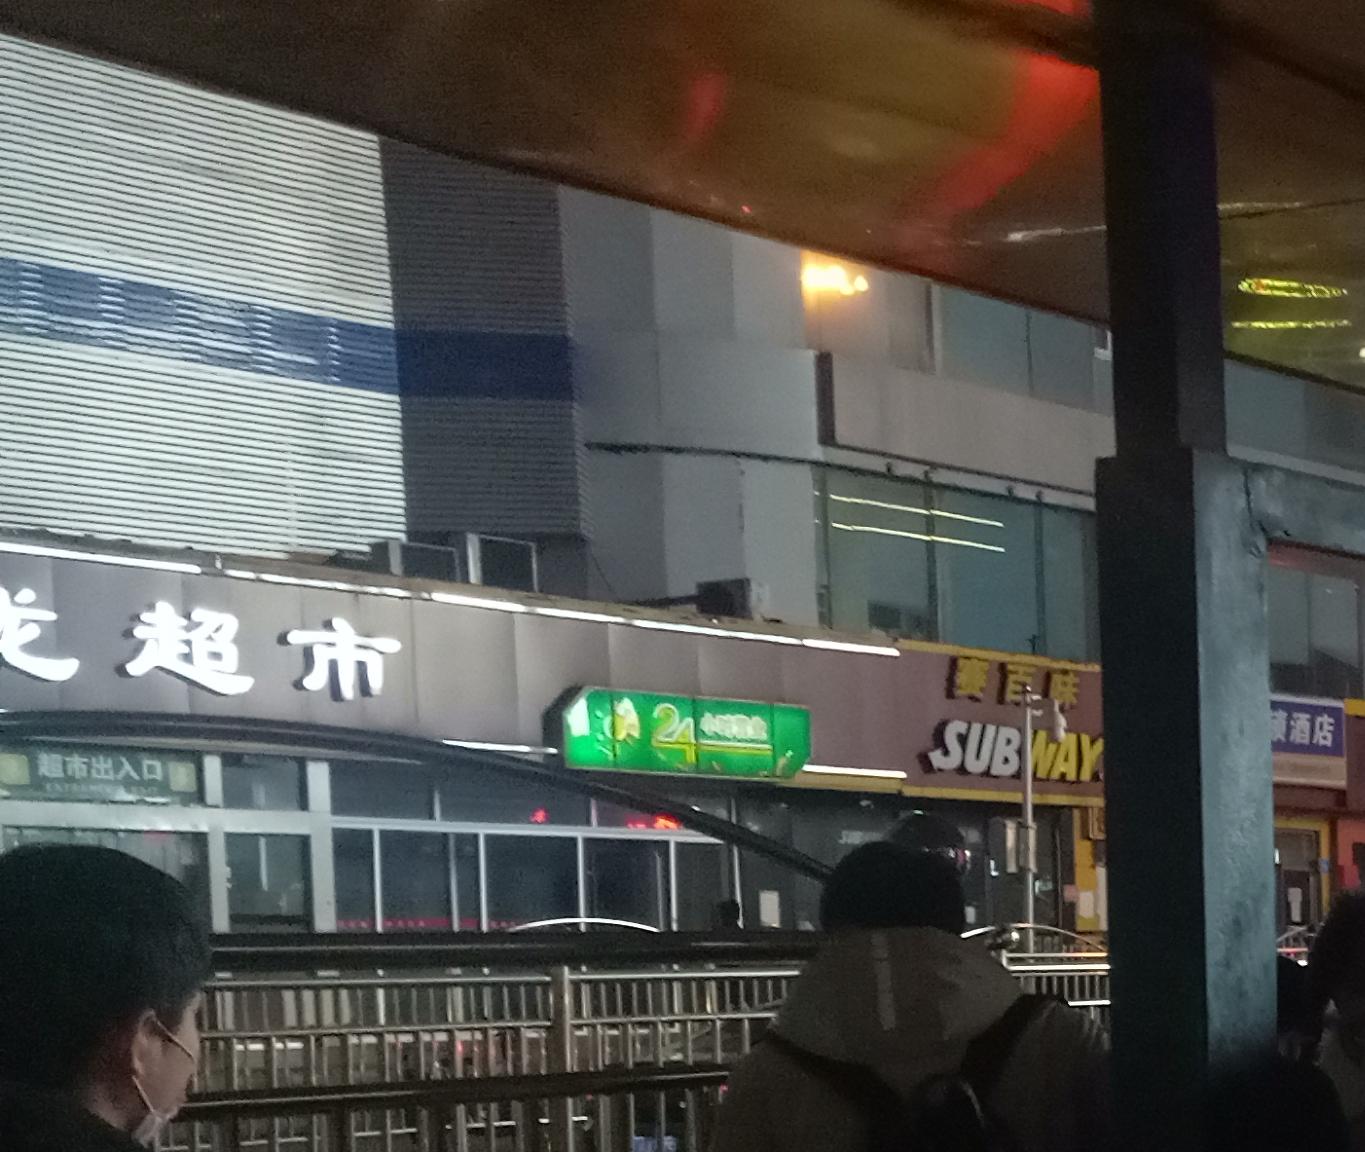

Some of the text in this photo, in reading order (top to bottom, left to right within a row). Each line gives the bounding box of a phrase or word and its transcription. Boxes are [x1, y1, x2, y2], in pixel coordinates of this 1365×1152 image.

[36, 752, 164, 782] 超市出入口
[928, 718, 1104, 783] SUBWAY
